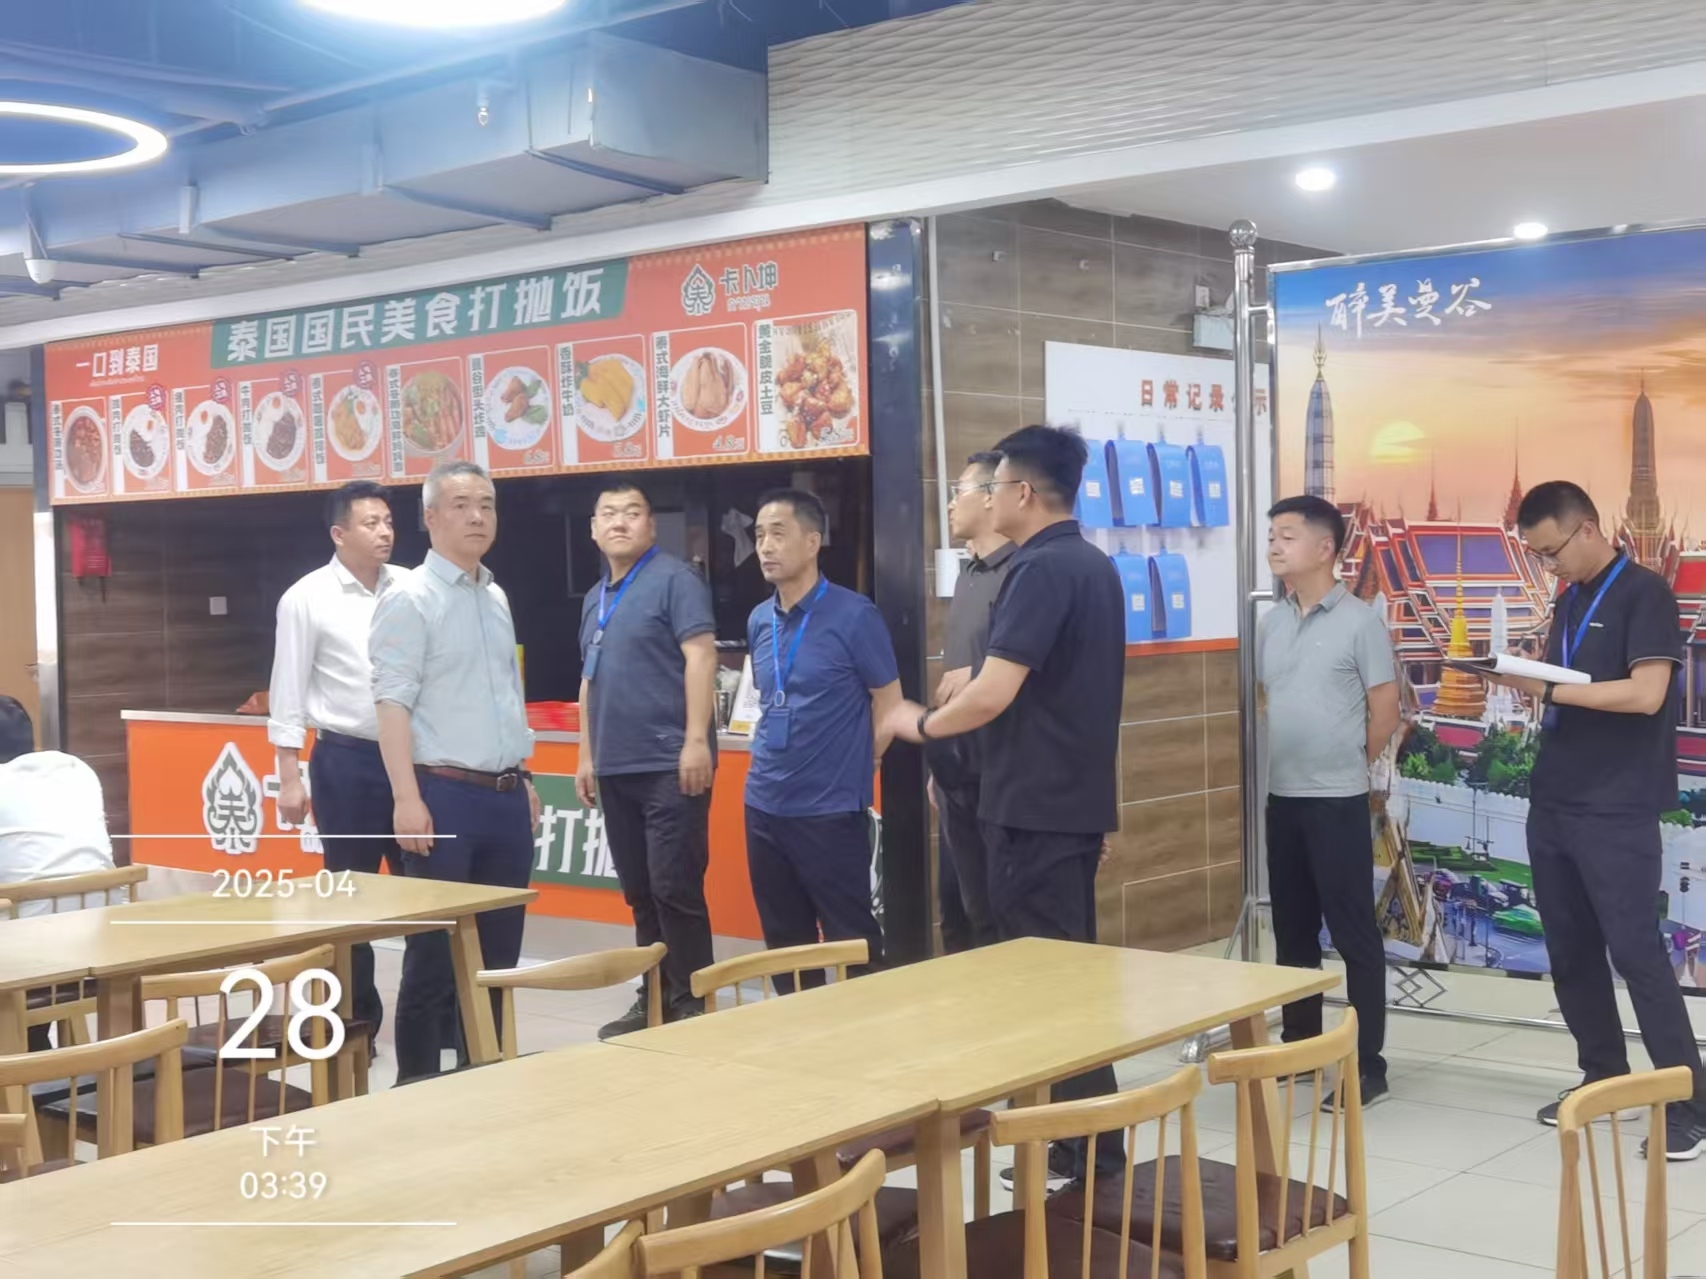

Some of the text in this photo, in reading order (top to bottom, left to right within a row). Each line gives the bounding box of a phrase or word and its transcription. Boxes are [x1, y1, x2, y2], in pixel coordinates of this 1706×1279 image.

[76, 344, 158, 377] 一口到泰国
[227, 268, 604, 362] 泰国国民美食打抛饭
[656, 336, 672, 437] 泰式海鲜大虾片
[758, 324, 774, 415] 黄金脆皮土豆
[1141, 379, 1267, 416] 日常记录示
